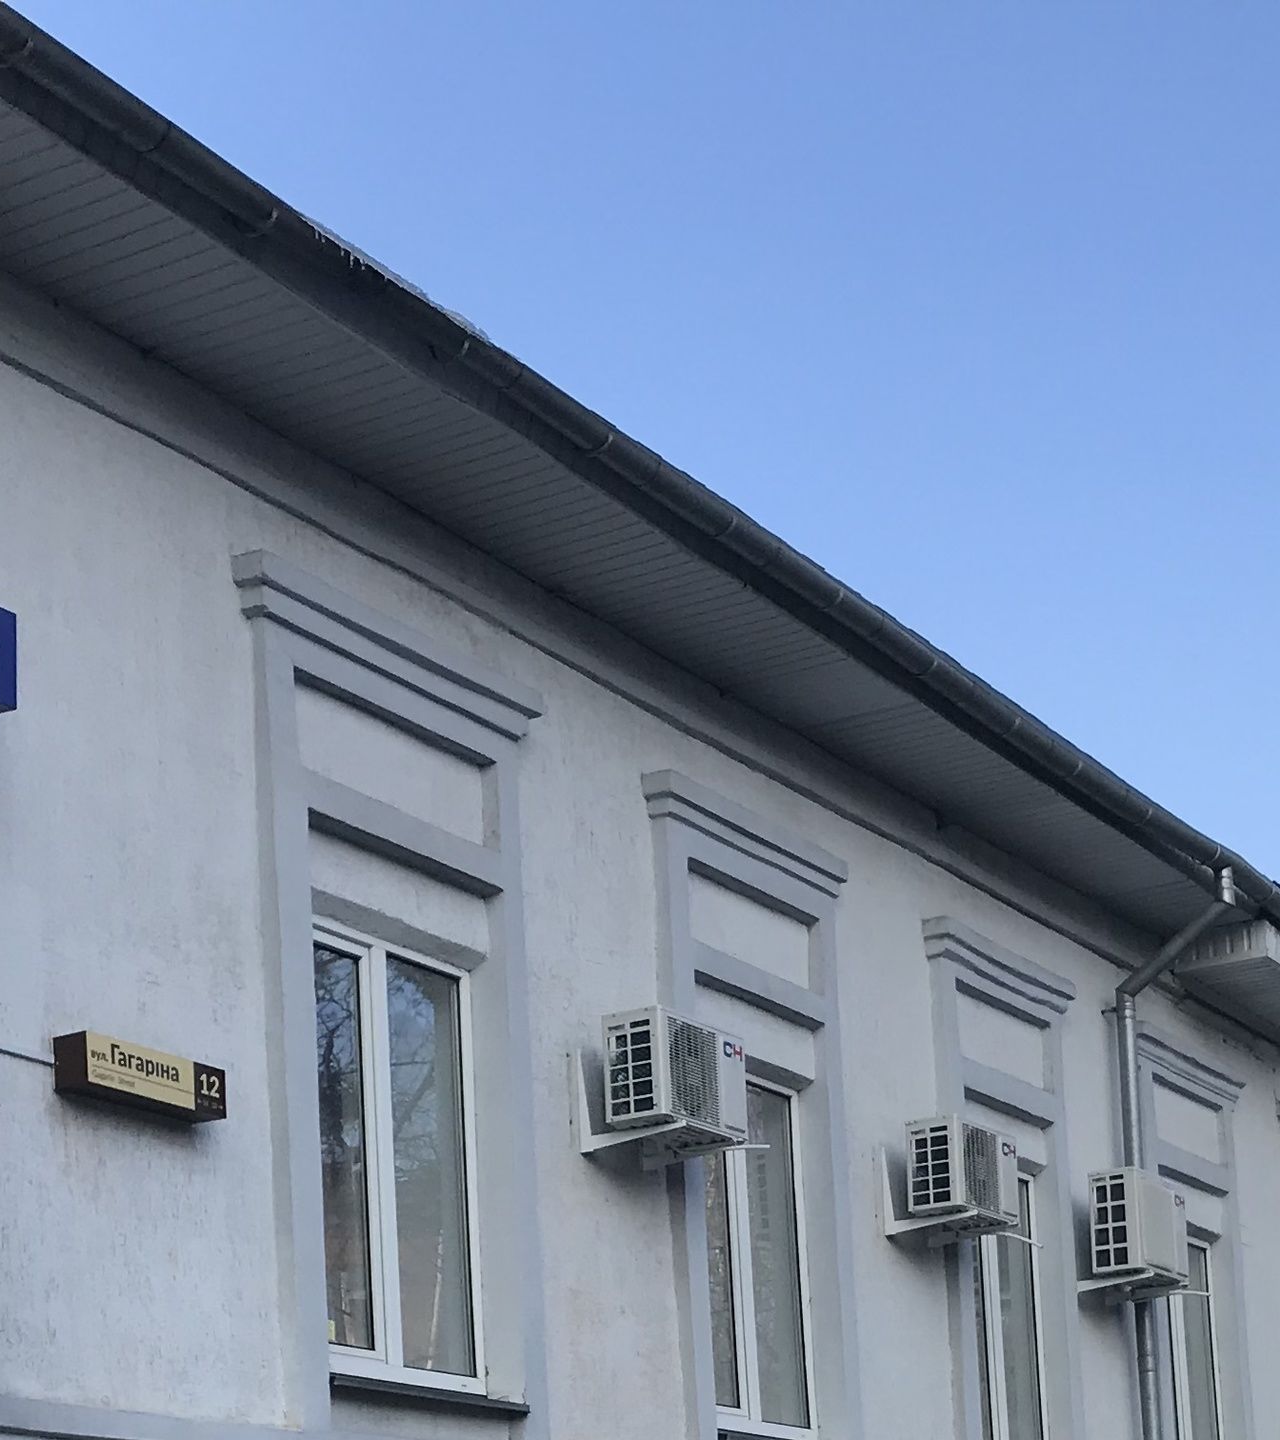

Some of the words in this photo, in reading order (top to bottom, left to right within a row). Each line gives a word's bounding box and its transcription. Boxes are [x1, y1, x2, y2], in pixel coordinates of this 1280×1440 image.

[111, 1043, 180, 1083] Гагаріна
[723, 1041, 743, 1062] CH
[200, 1073, 220, 1098] 12
